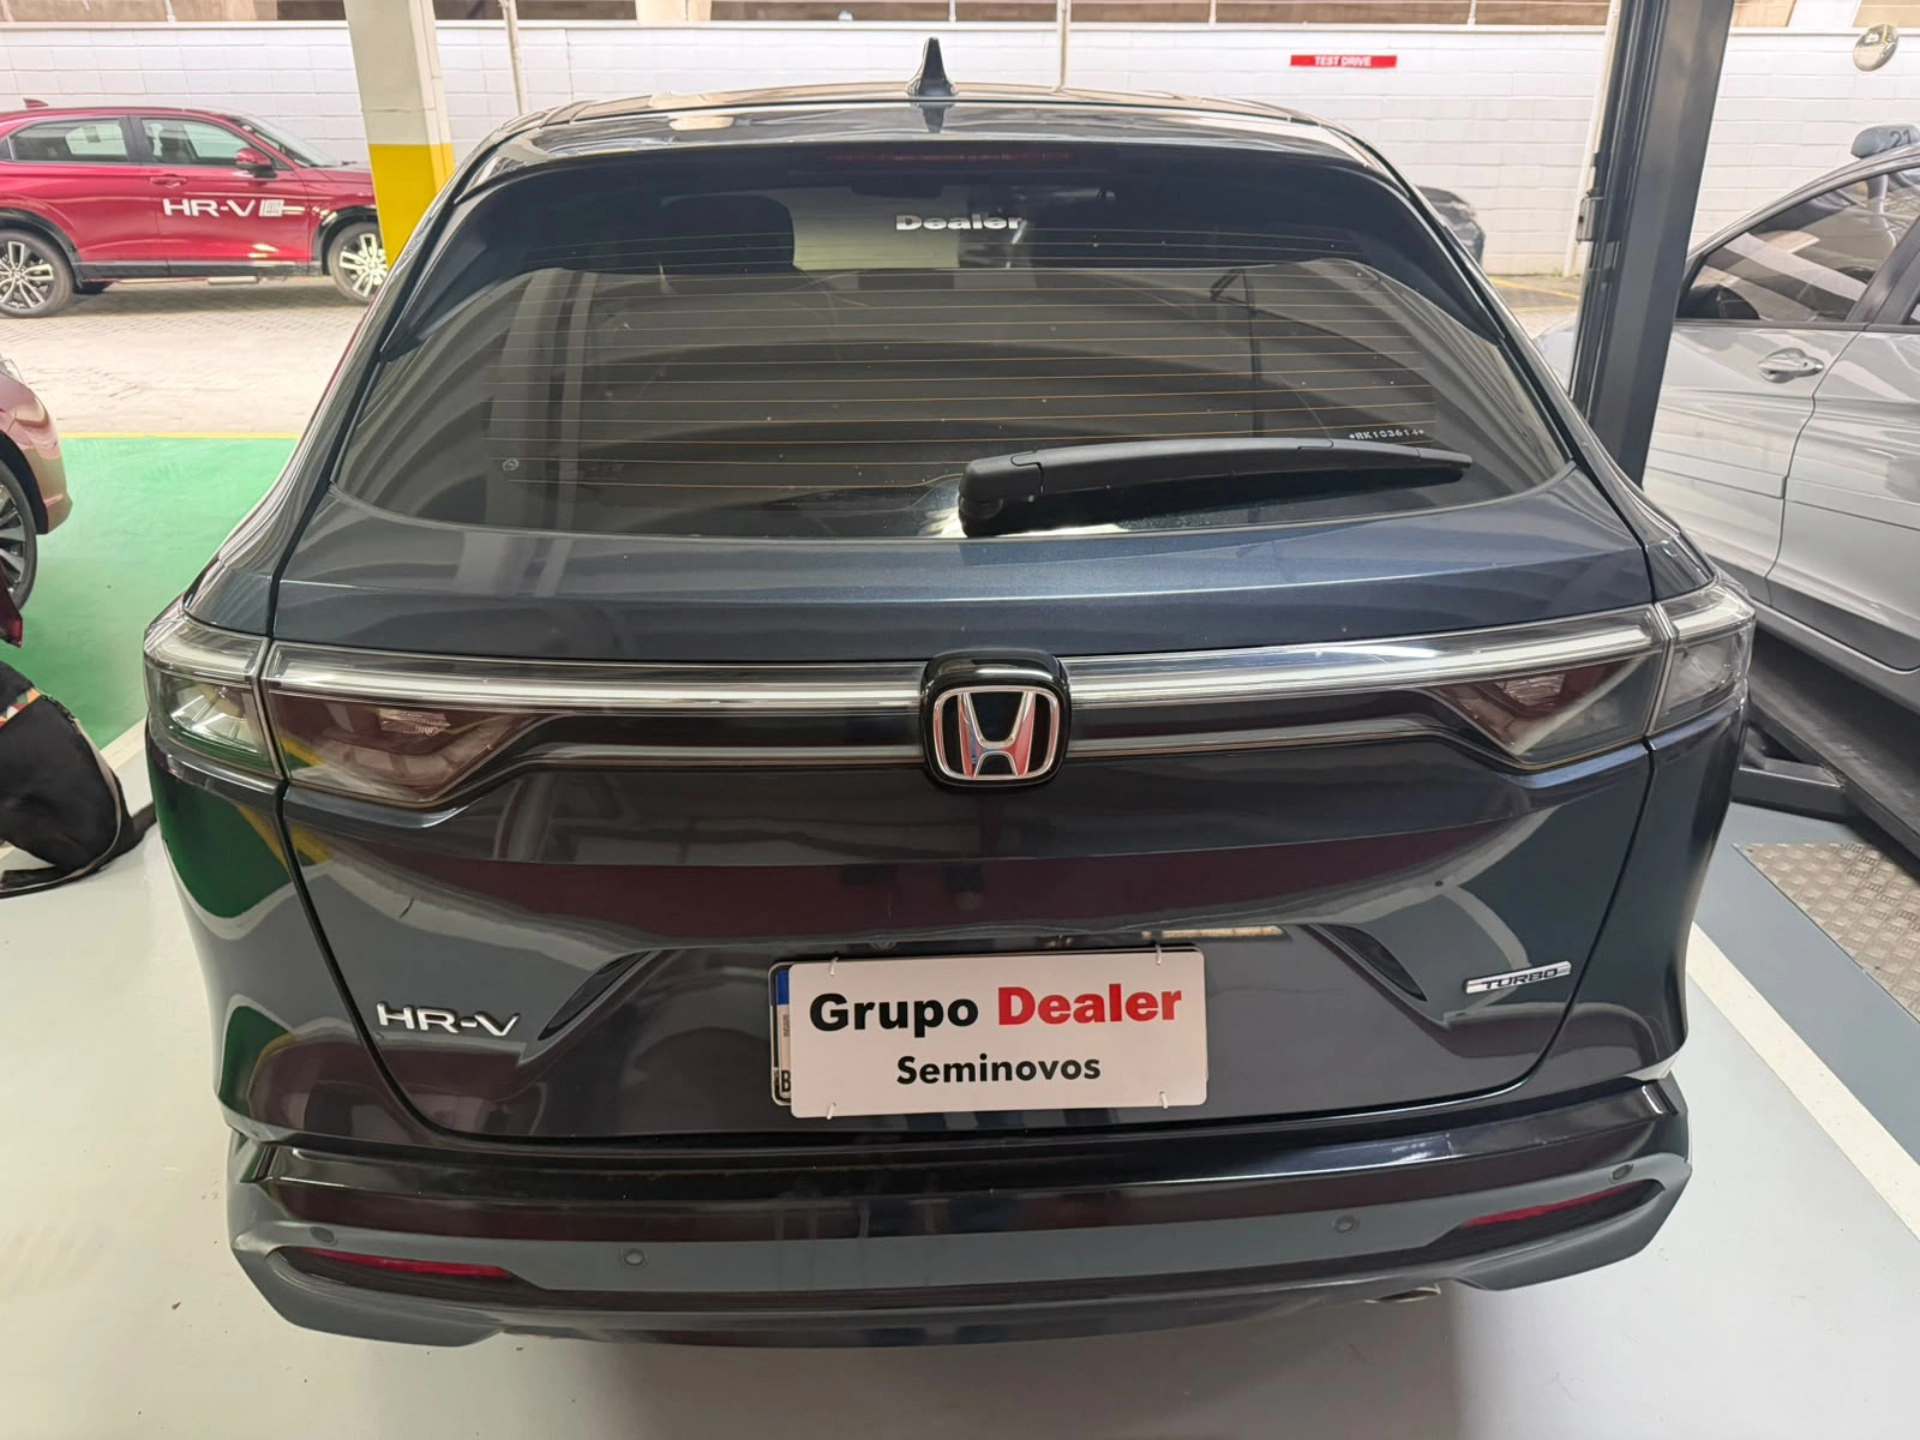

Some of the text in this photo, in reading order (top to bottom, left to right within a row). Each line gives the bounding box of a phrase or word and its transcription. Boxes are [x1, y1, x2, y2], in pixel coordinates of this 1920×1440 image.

[162, 198, 256, 217] HR-V
[896, 213, 1023, 231] Dealer
[1481, 967, 1559, 990] TURBO
[376, 1002, 520, 1037] HR-V
[809, 983, 1183, 1039] Grupo Dealer
[897, 1053, 1101, 1085] Seminovos
